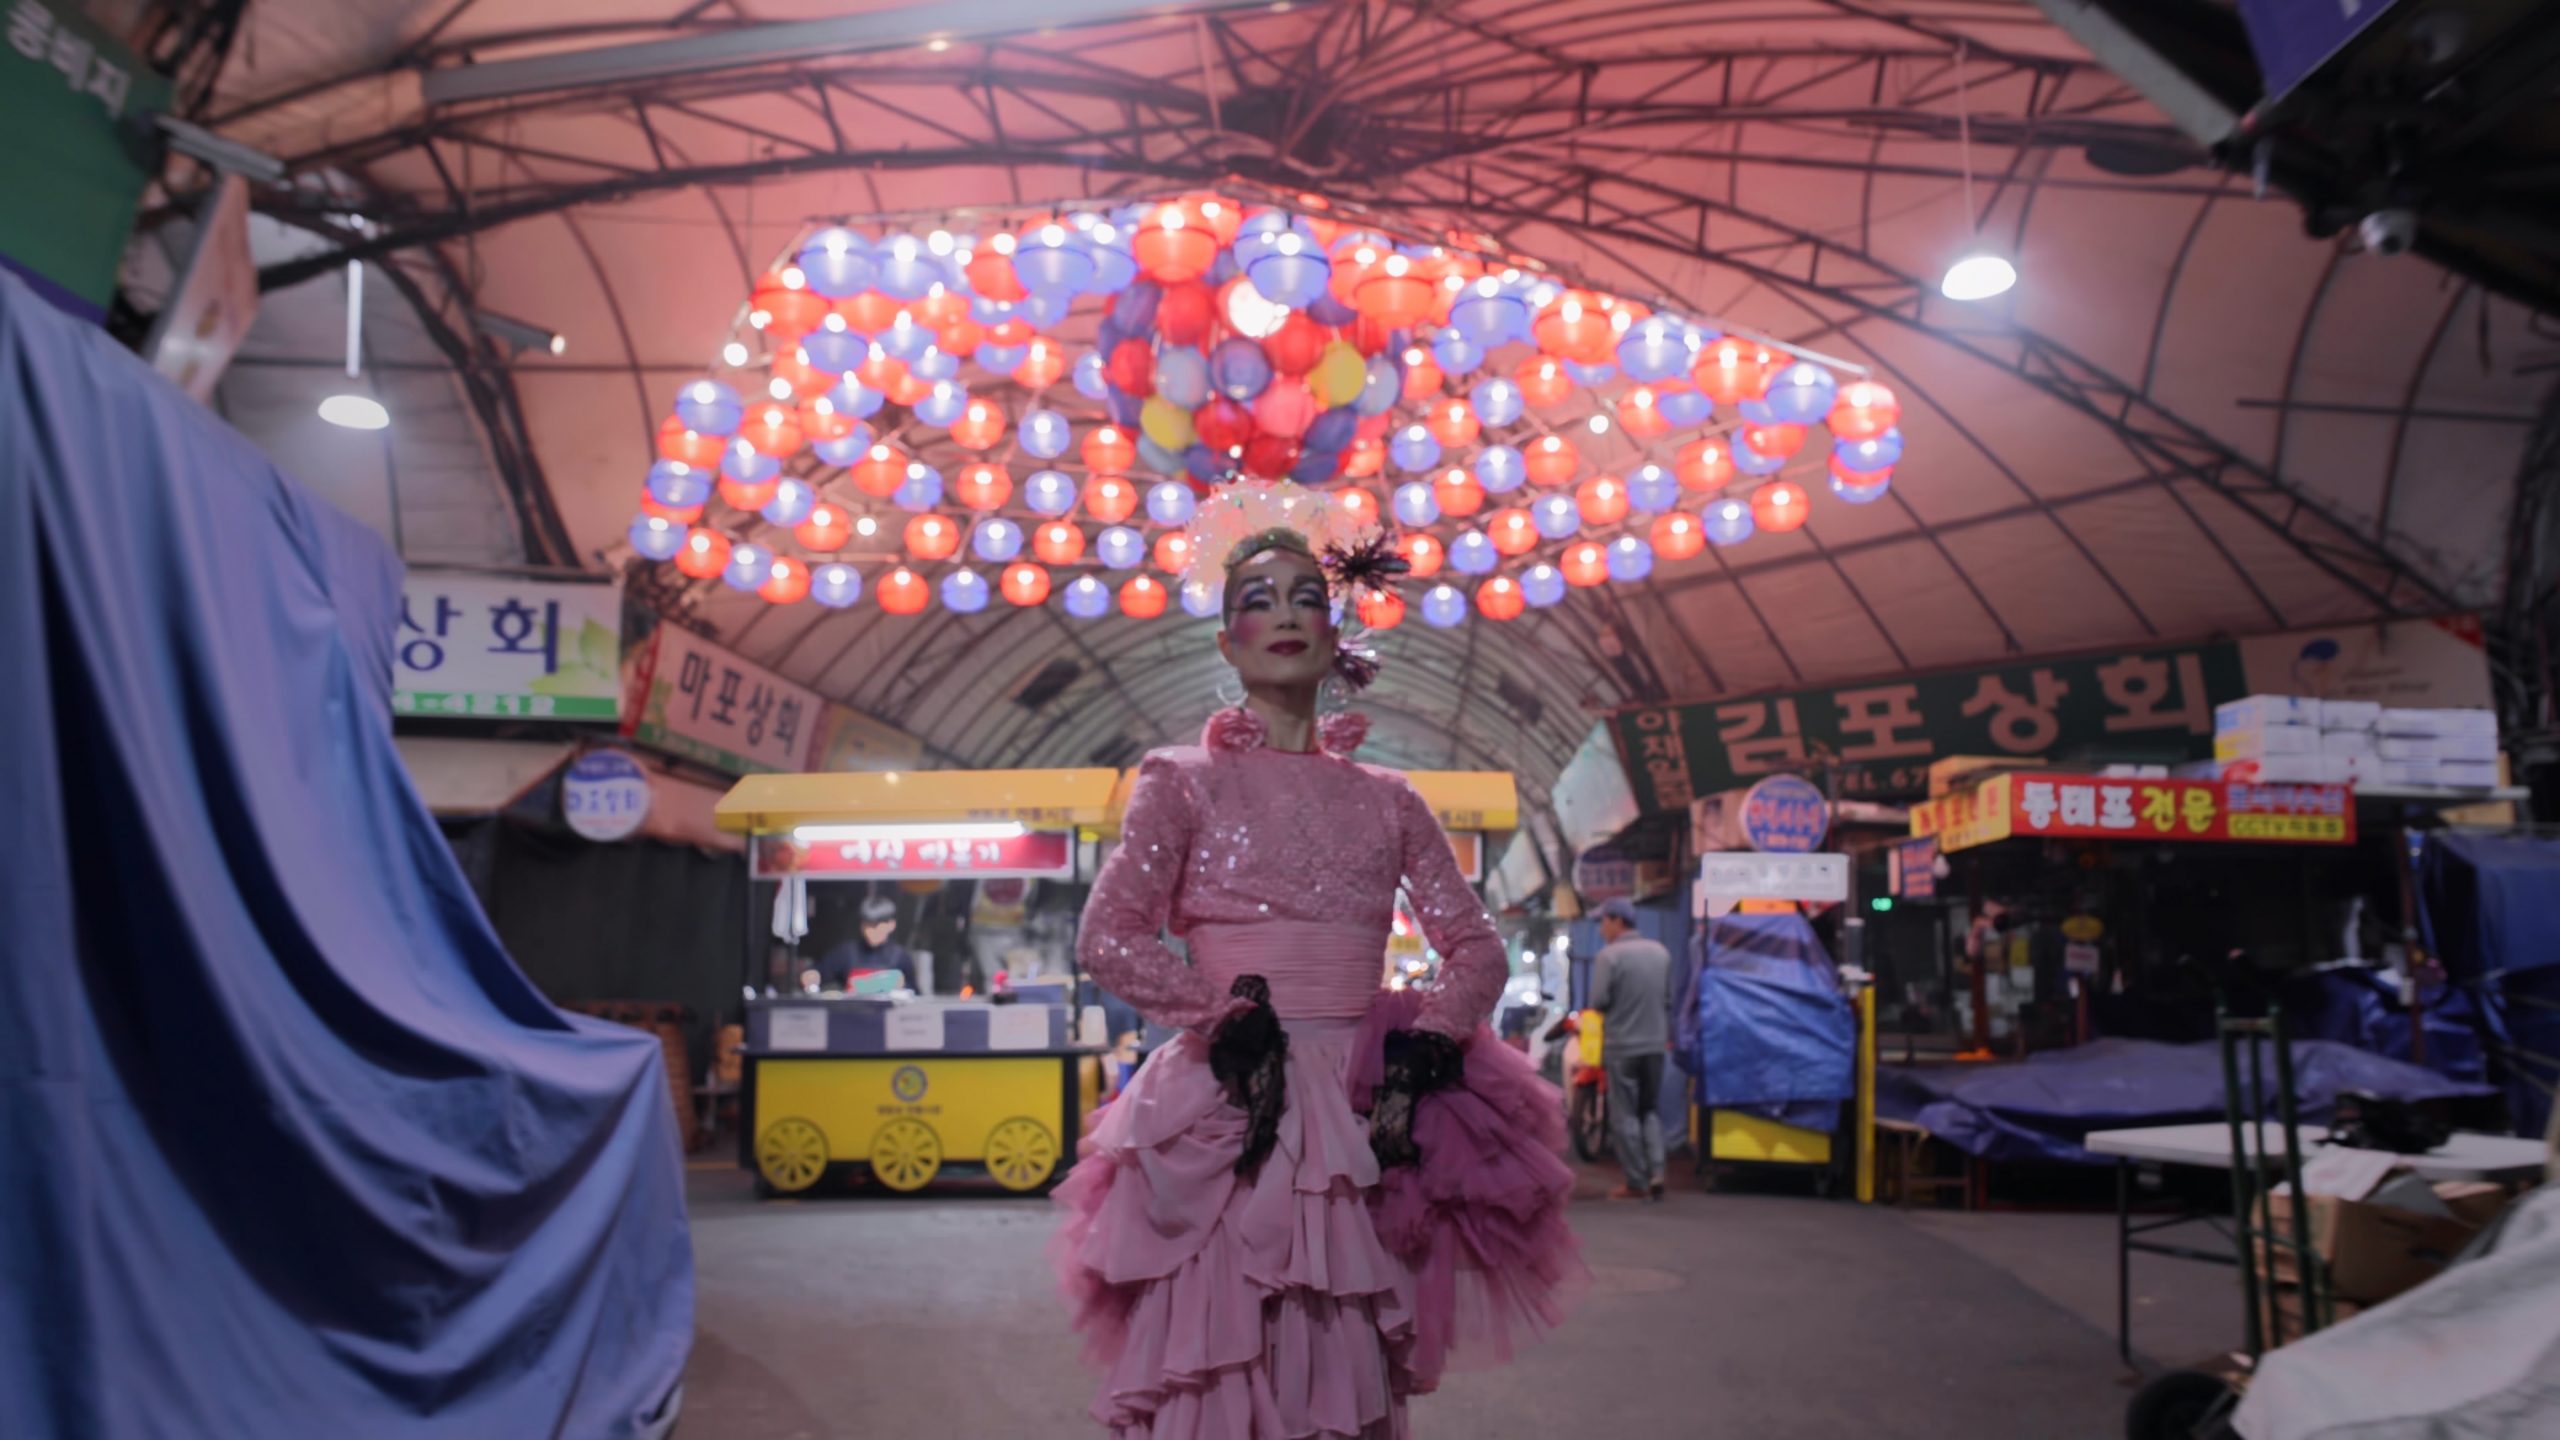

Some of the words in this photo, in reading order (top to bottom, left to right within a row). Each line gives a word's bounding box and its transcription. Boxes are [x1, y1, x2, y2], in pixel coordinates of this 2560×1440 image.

[401, 594, 560, 676] 상회
[679, 651, 802, 756] 마포상회
[1716, 653, 2214, 776] 김포상회
